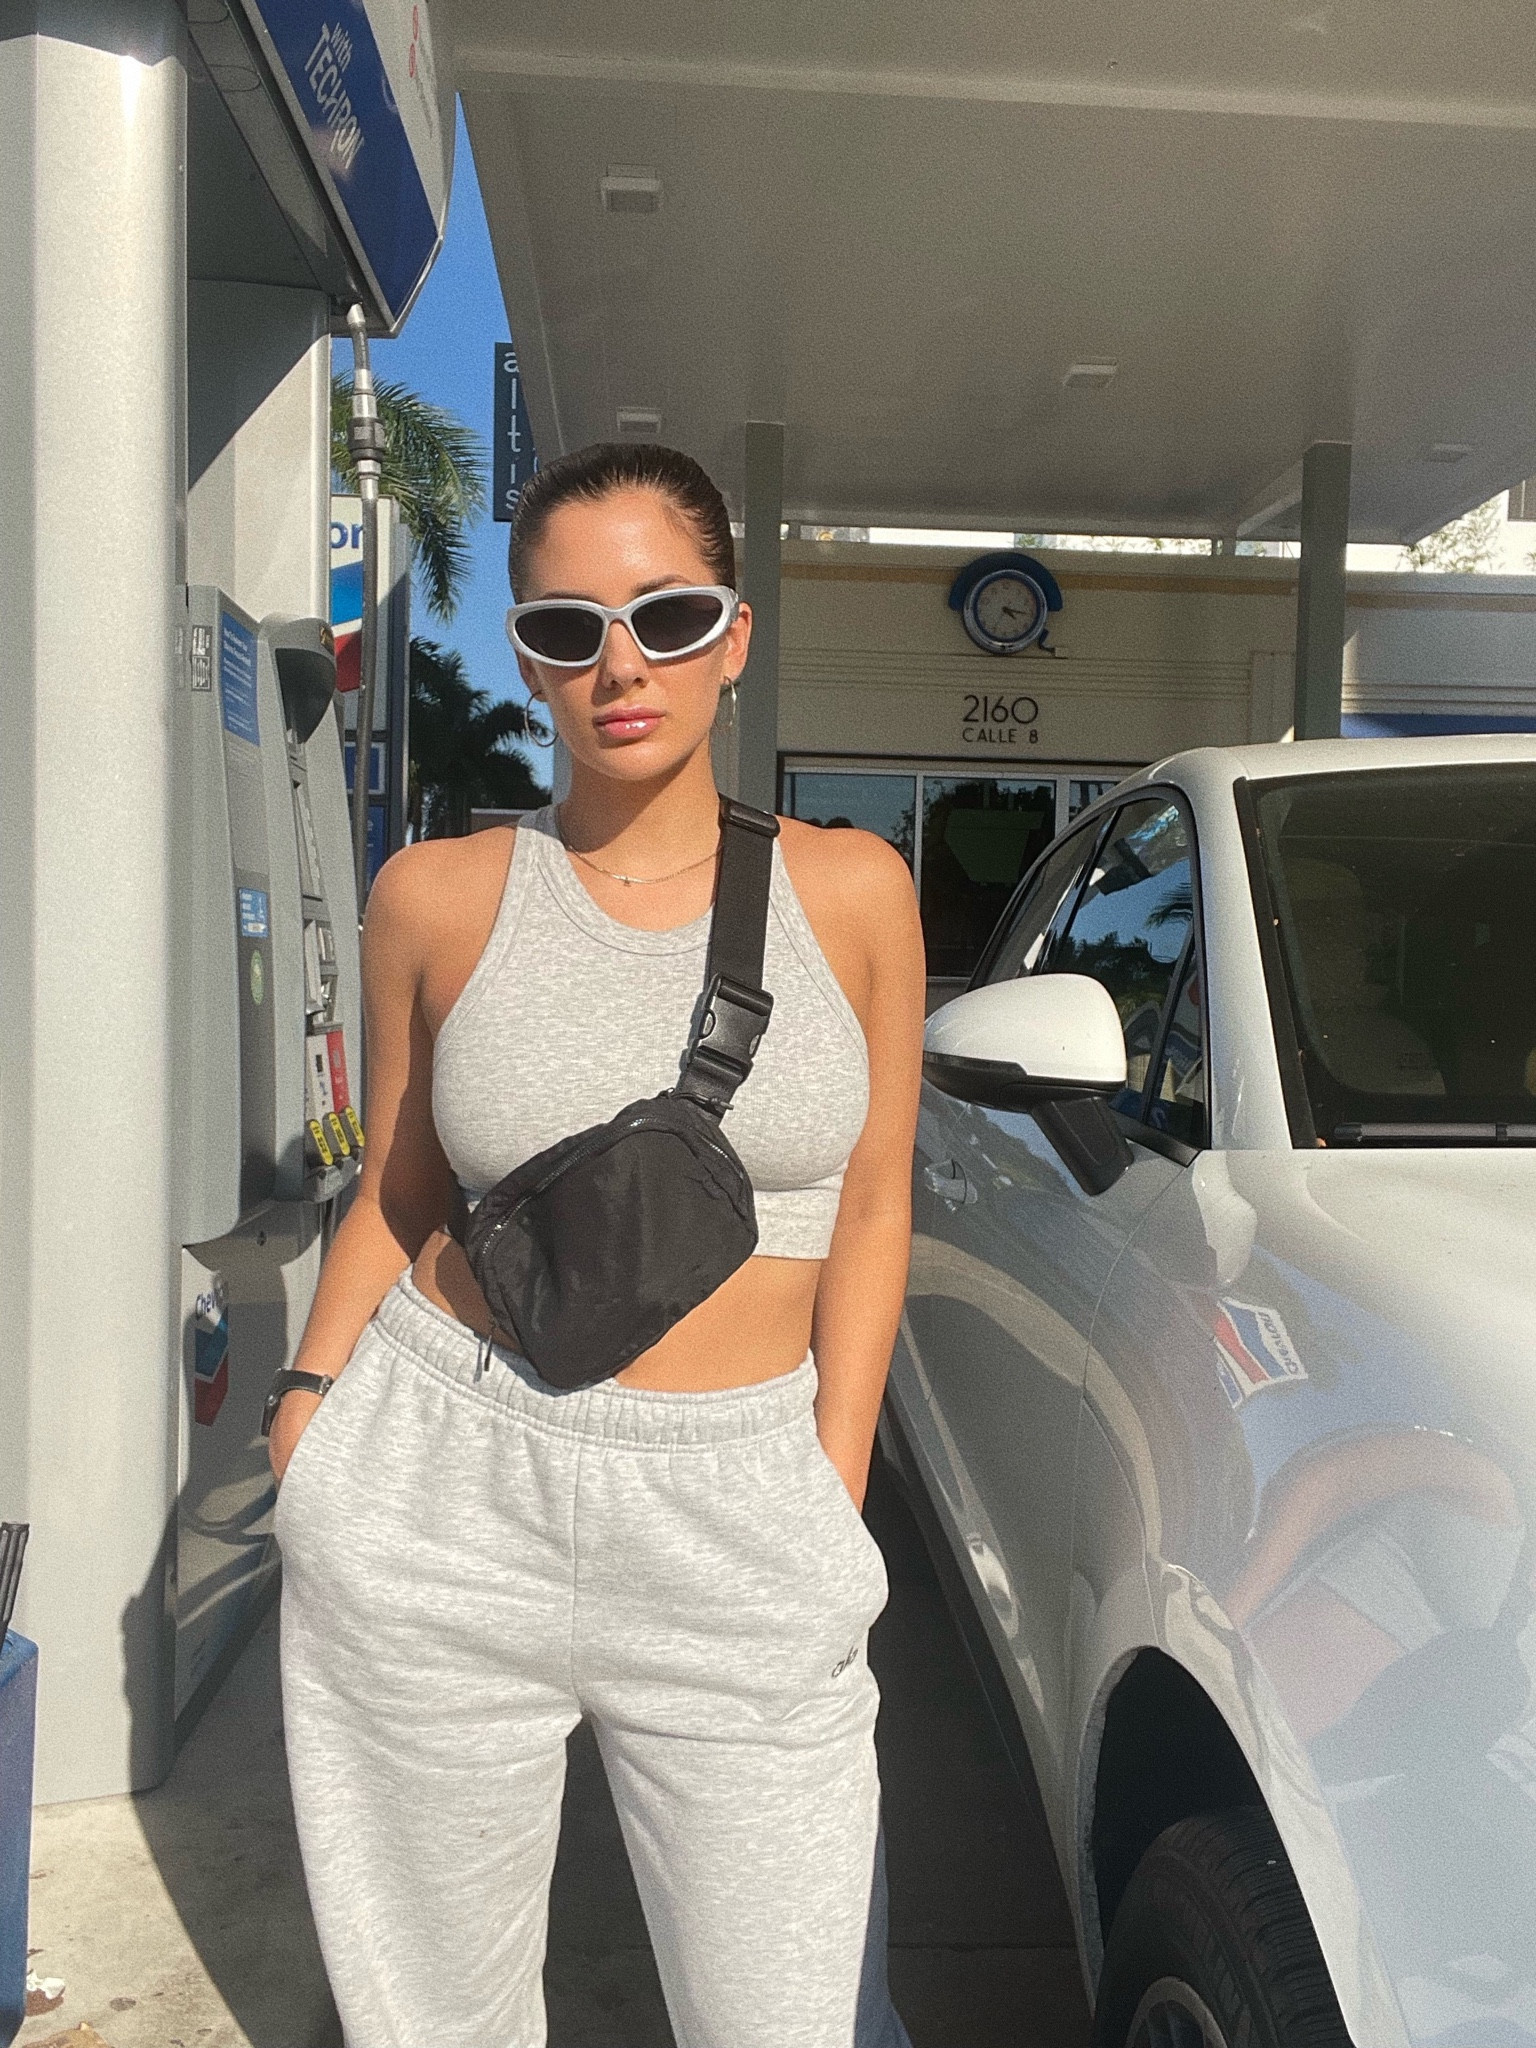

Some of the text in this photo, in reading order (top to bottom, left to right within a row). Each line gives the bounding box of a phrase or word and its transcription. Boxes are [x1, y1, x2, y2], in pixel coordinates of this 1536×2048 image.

[304, 22, 365, 170] TECHRON
[962, 694, 1039, 724] 2160
[962, 727, 1039, 744] CALLE 8
